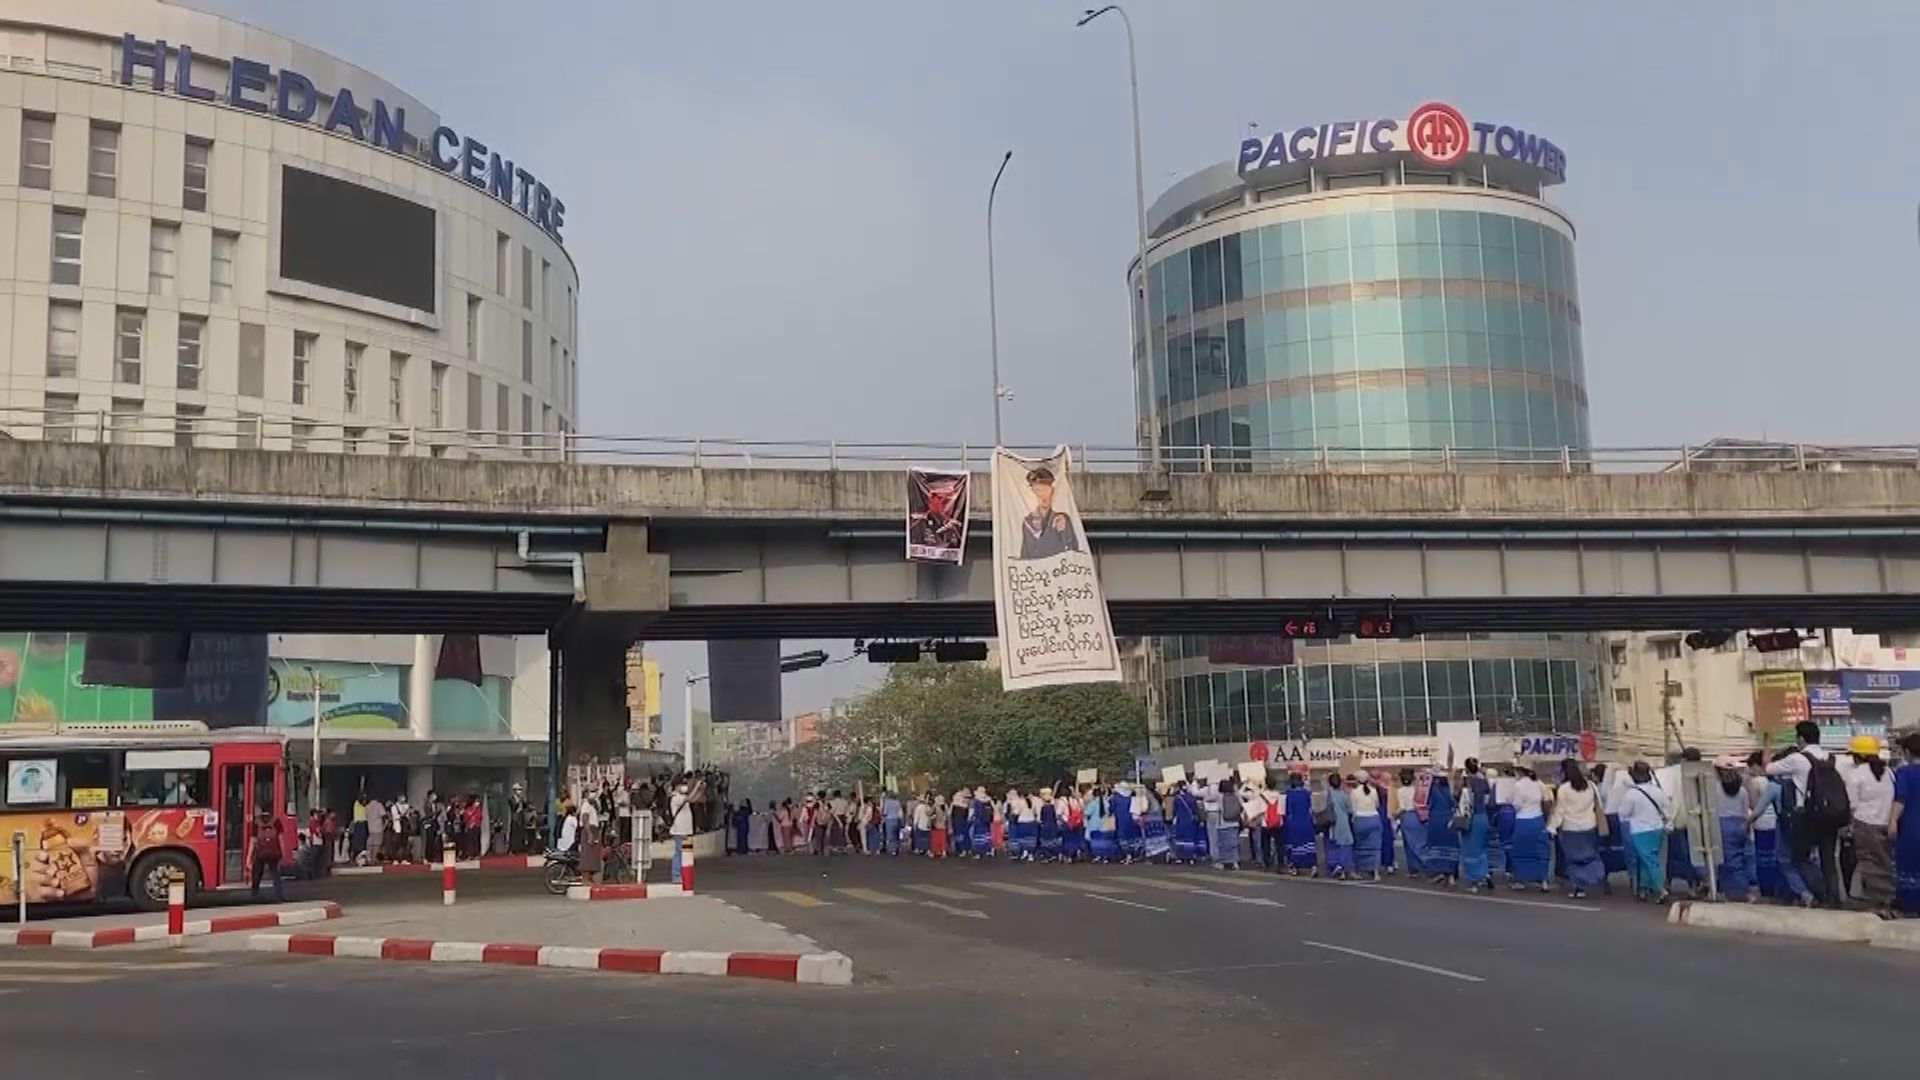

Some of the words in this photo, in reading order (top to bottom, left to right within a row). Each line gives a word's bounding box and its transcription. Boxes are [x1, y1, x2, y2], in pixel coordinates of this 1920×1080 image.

[120, 31, 406, 154] HLEDAN
[430, 125, 567, 244] CENTRE
[1237, 118, 1399, 176] PACIFIC
[1473, 121, 1567, 182] TOWER
[1274, 745, 1304, 763] AA
